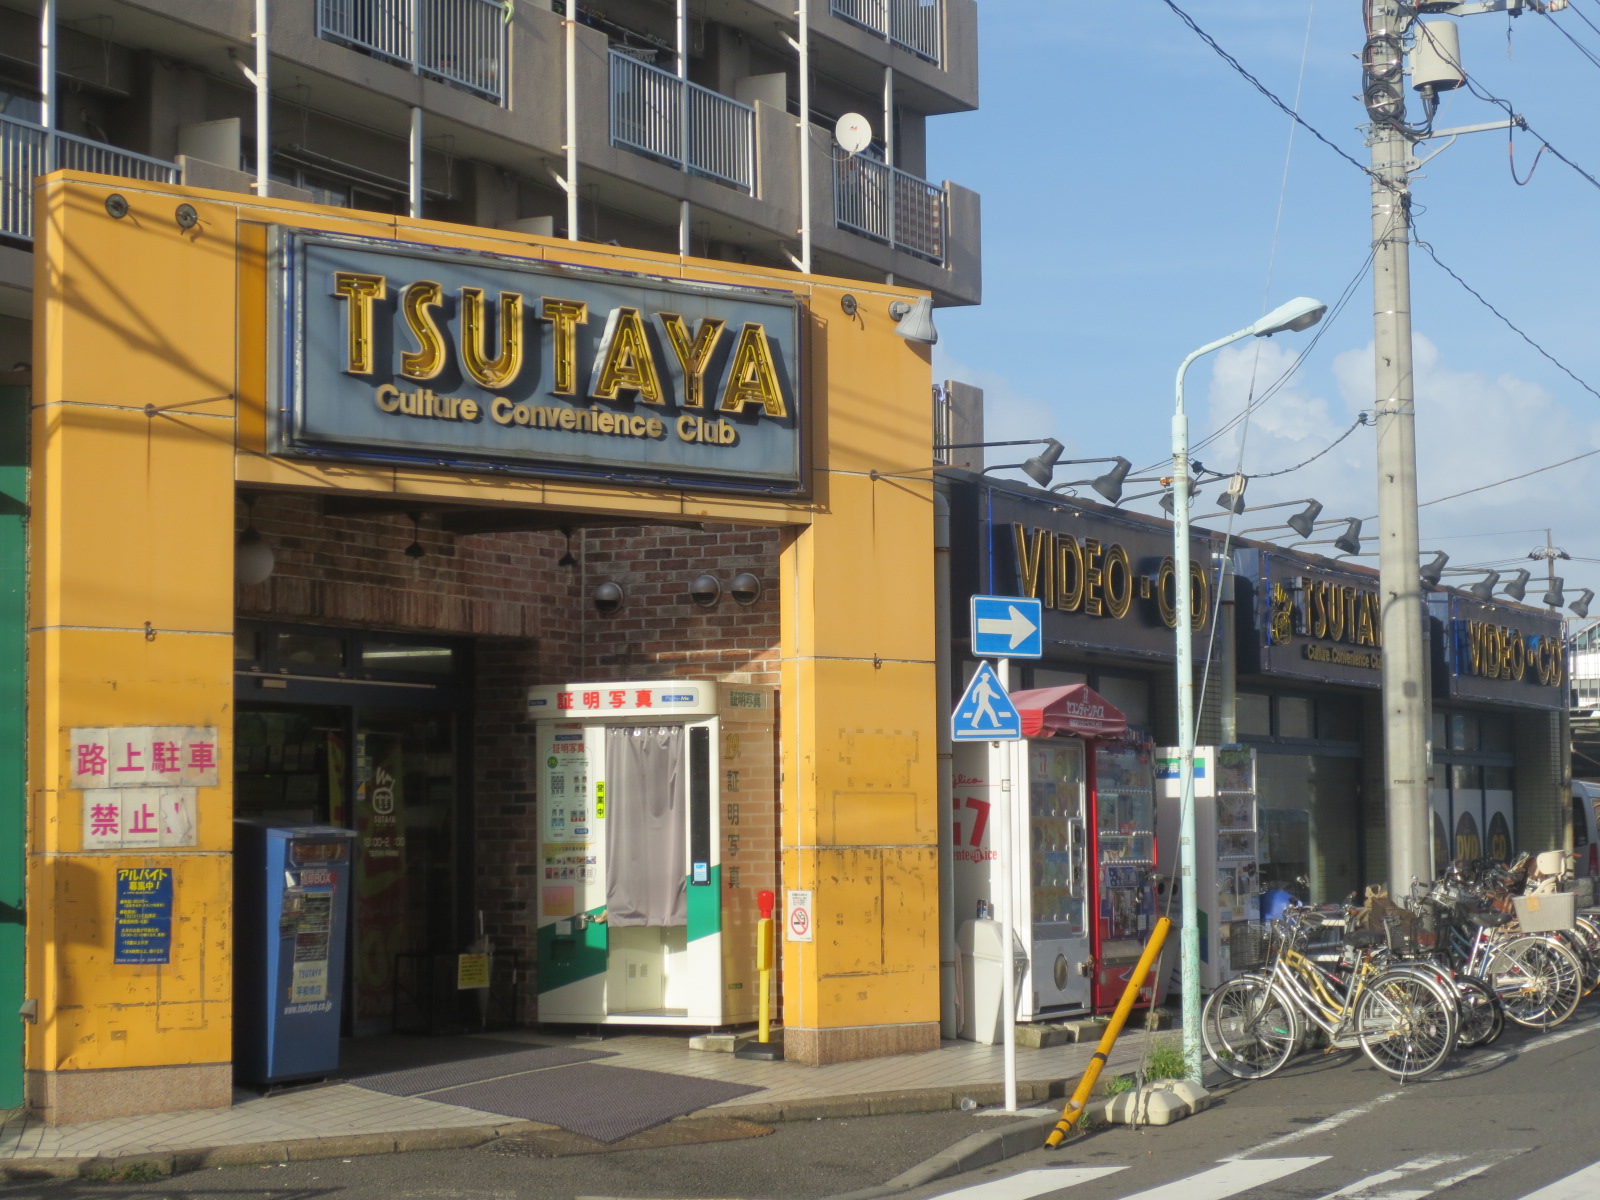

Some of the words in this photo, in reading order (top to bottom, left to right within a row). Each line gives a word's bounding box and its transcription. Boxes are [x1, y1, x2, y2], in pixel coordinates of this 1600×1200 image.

[333, 271, 788, 419] TSUTAYA
[376, 384, 478, 421] Culture
[490, 402, 664, 439] Convenience
[676, 414, 737, 445] Club
[1299, 576, 1383, 647] TSUTAY
[1307, 643, 1331, 662] Culture
[1332, 648, 1370, 668] Convenience
[1370, 654, 1383, 670] Clu
[556, 690, 653, 710] 証明写真
[730, 690, 762, 708] 証明写真
[77, 740, 216, 776] 路上駐車
[552, 743, 586, 754] 証明写真
[1155, 762, 1180, 774] 伊藤
[726, 770, 741, 889] 証明写真
[1455, 834, 1481, 861] DVD
[1493, 834, 1507, 861] CD
[118, 868, 168, 881] アルバイト
[284, 1001, 332, 1015] www.tsutaya.co.jp
